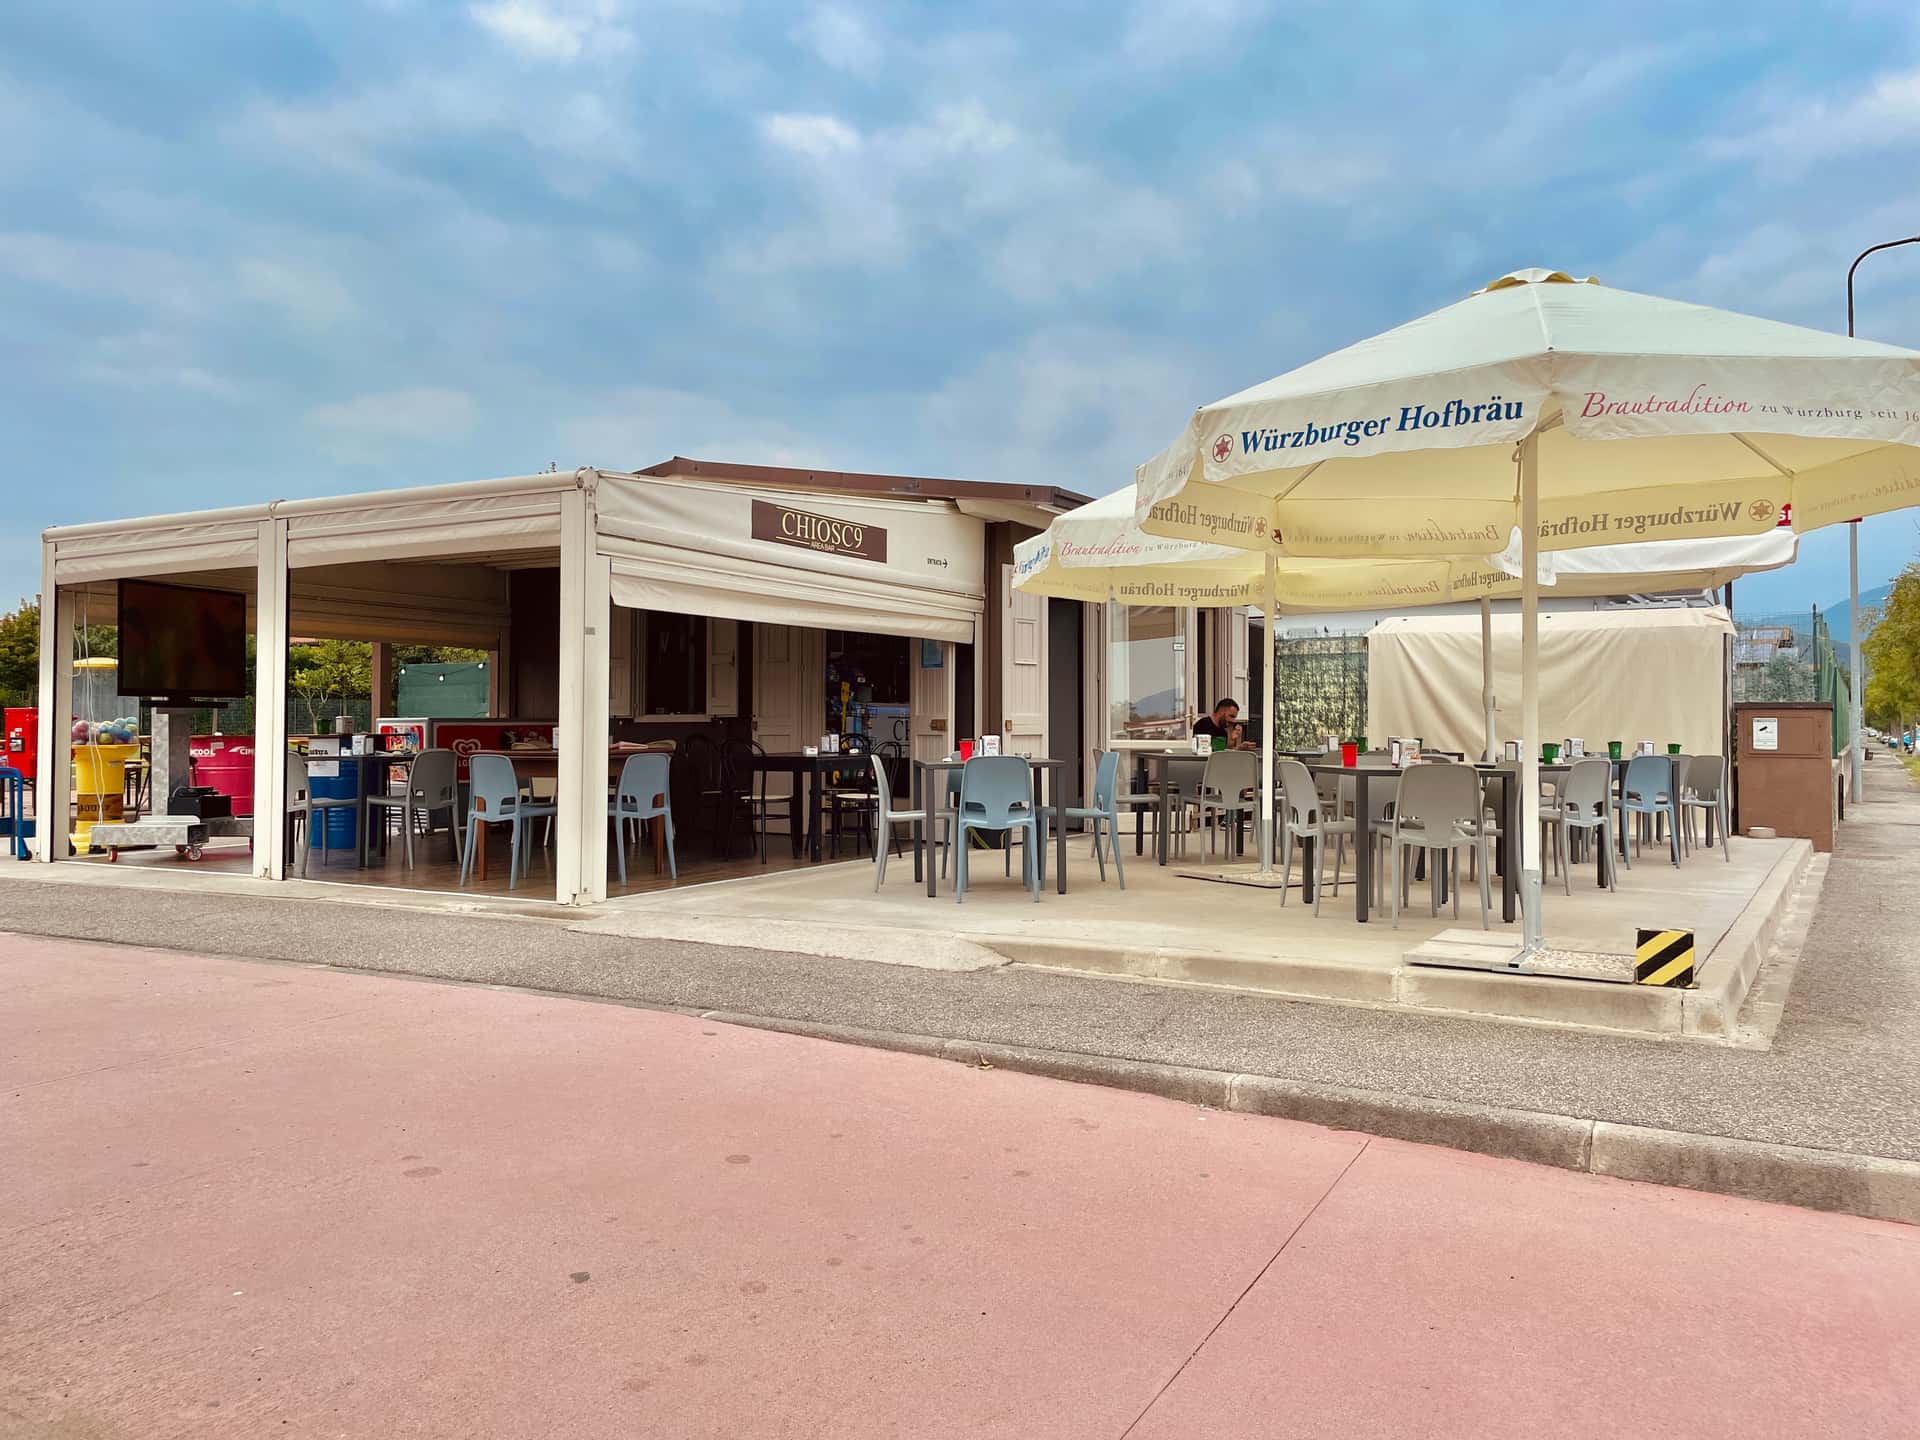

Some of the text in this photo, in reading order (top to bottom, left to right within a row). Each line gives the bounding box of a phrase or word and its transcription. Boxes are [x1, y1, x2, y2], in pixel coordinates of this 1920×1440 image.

[1580, 383, 1753, 418] Brautradition
[1241, 396, 1524, 454] Würzburger Hofbräu
[781, 511, 864, 549] CHIOSC9
